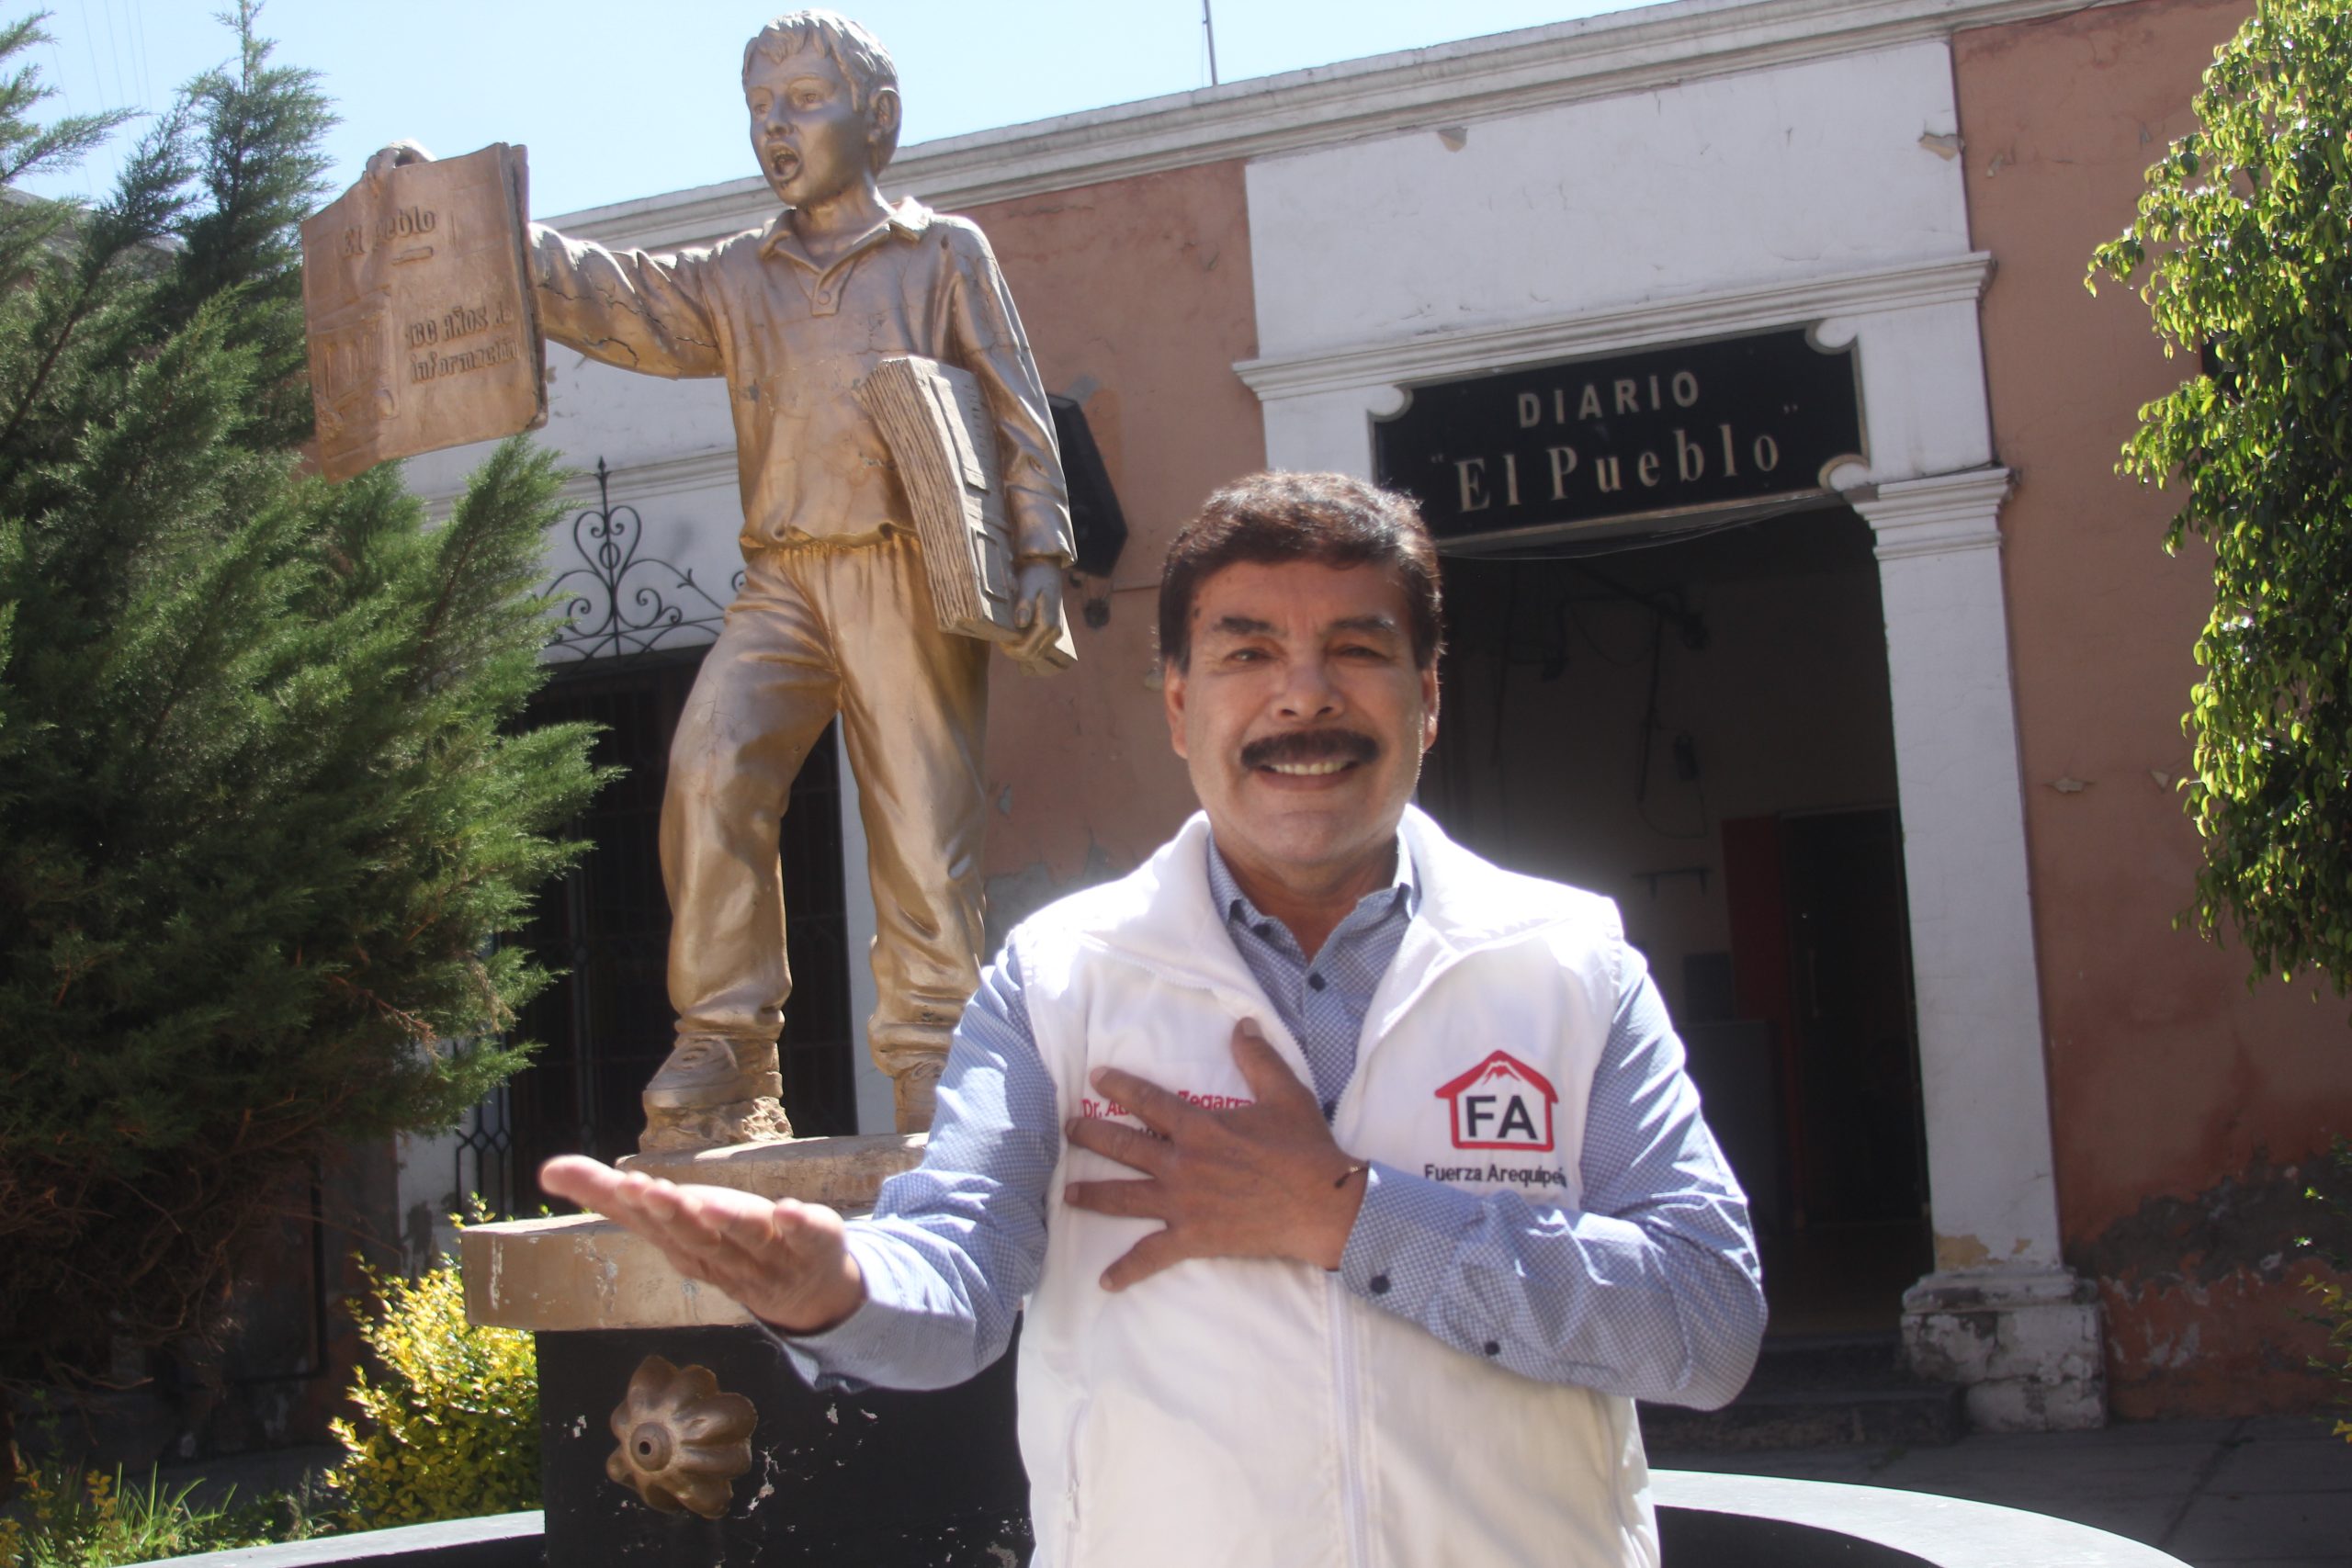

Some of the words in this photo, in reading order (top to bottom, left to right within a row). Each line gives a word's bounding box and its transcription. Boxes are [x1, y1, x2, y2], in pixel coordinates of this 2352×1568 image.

[1518, 371, 1699, 428] DIARIO
[1081, 1099, 1102, 1118] Dr.
[1465, 1094, 1539, 1140] FA
[1424, 1164, 1482, 1182] Fuerza
